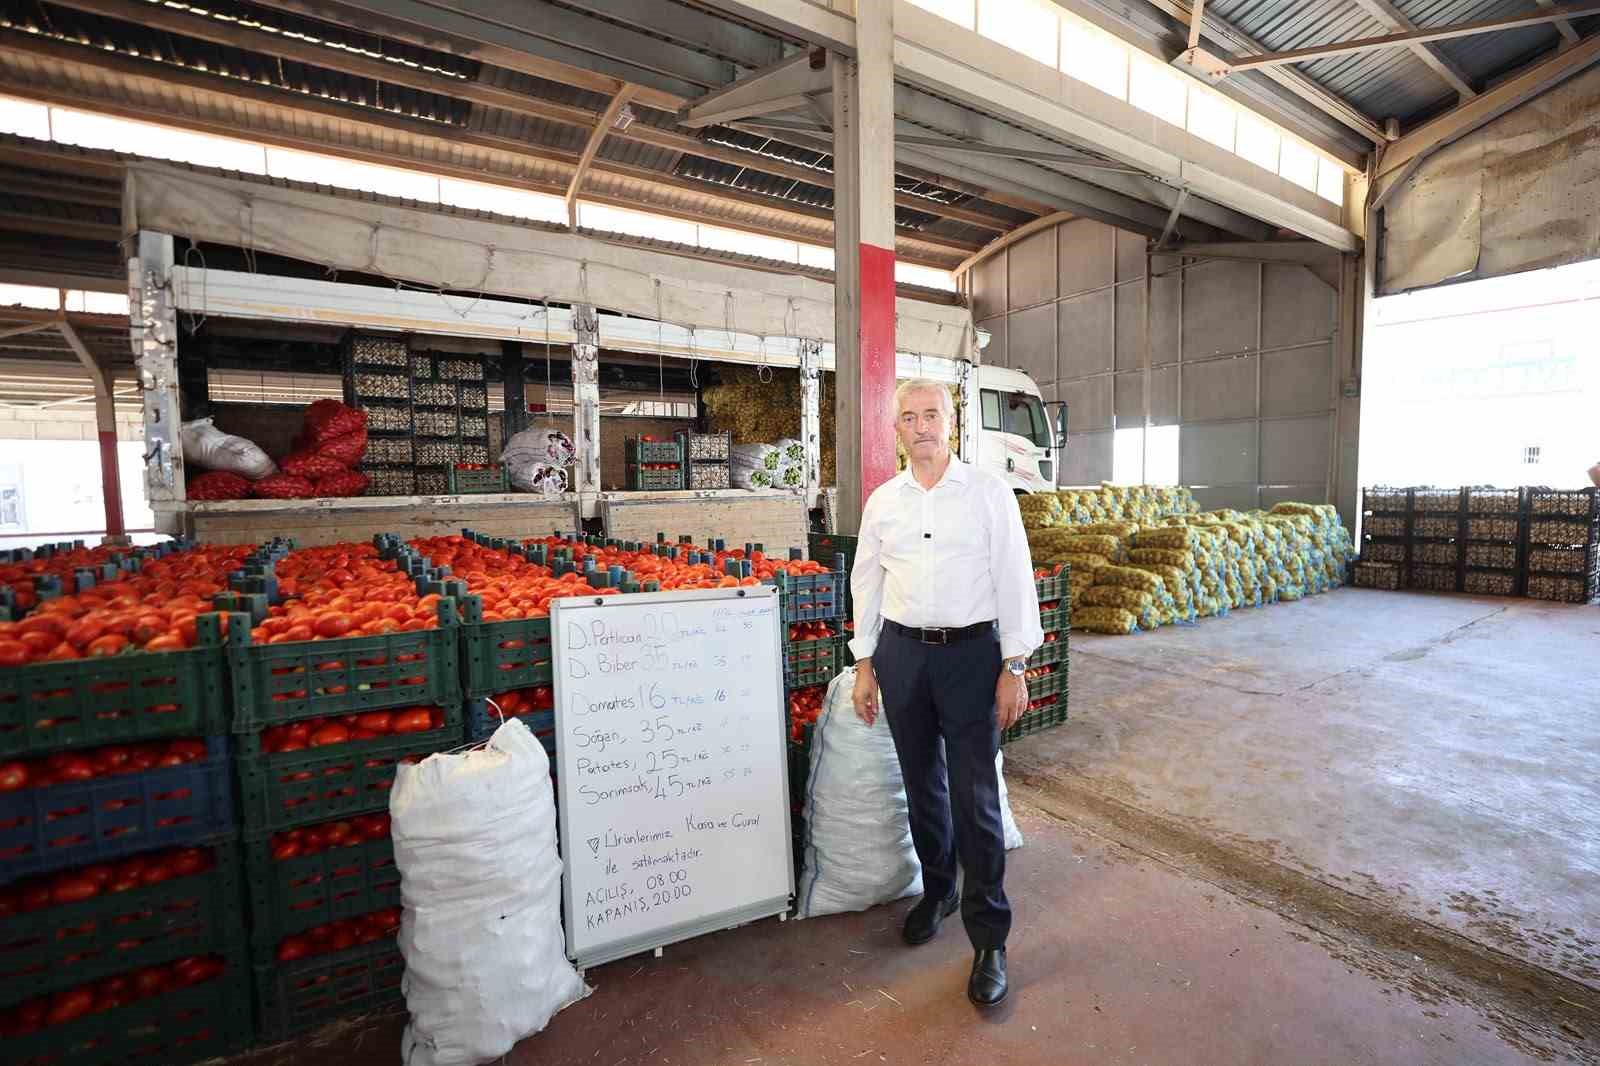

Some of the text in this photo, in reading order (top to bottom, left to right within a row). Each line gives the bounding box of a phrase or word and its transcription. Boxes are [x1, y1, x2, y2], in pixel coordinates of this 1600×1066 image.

[597, 652, 640, 673] Biber
[571, 691, 636, 716] Domates
[639, 682, 667, 709] 16
[640, 715, 675, 743] 35
[645, 748, 681, 774] 25
[654, 774, 685, 800] 45
